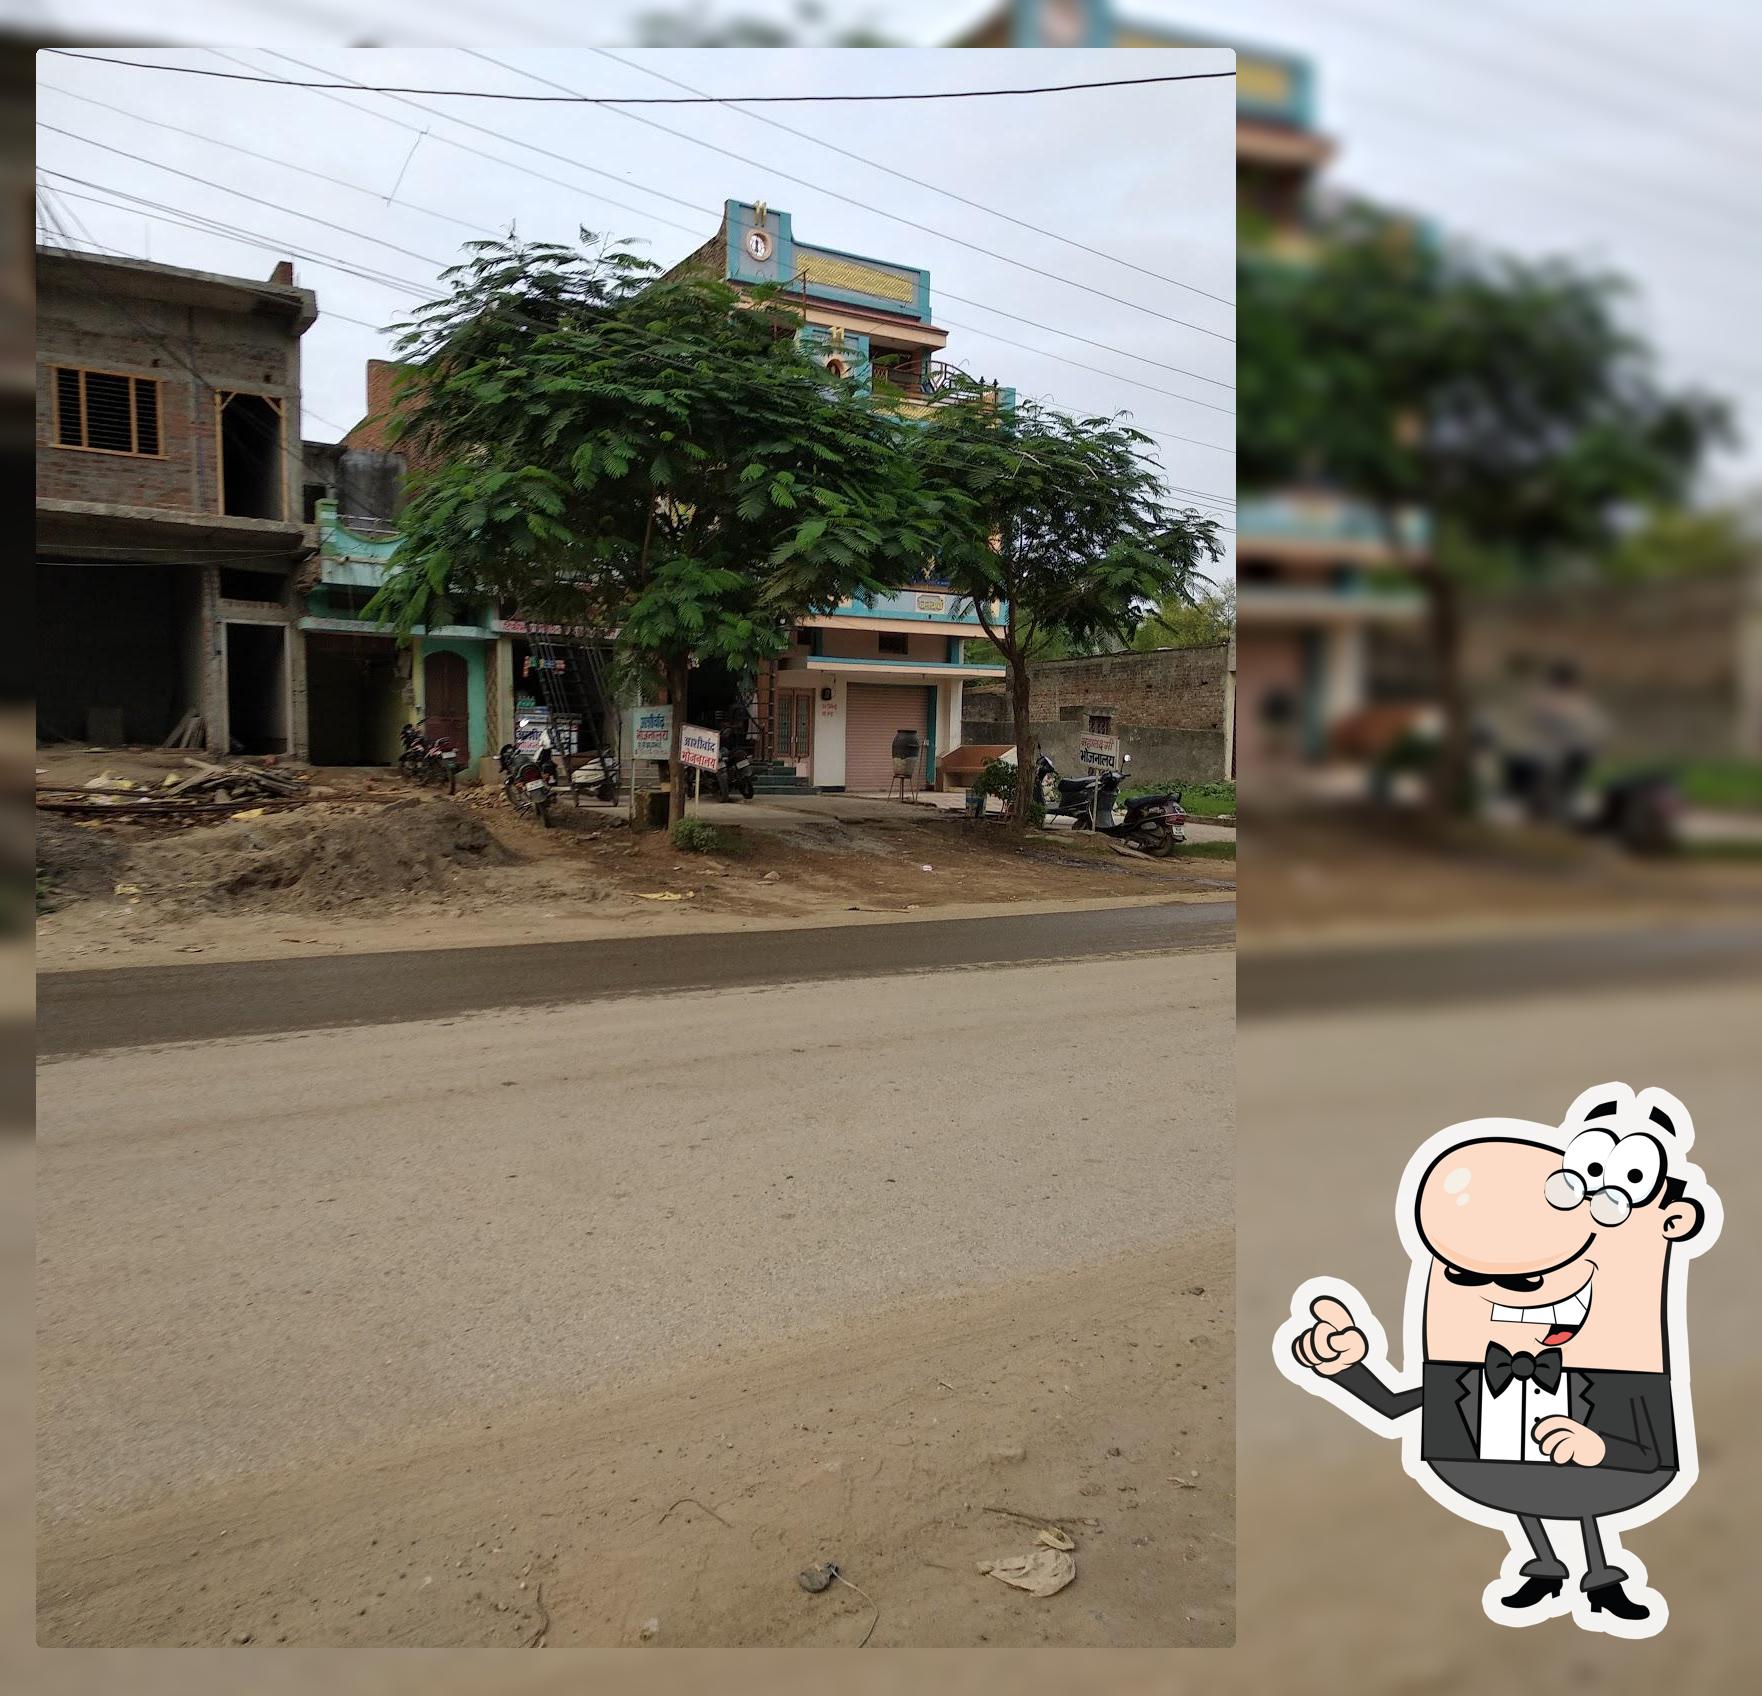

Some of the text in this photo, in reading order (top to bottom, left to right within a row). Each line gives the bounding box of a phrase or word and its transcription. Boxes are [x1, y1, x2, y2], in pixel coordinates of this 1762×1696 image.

[684, 735, 716, 753] आशीर्वाद
[682, 749, 716, 769] भोजनालय
[1080, 747, 1115, 768] भोजनालय
